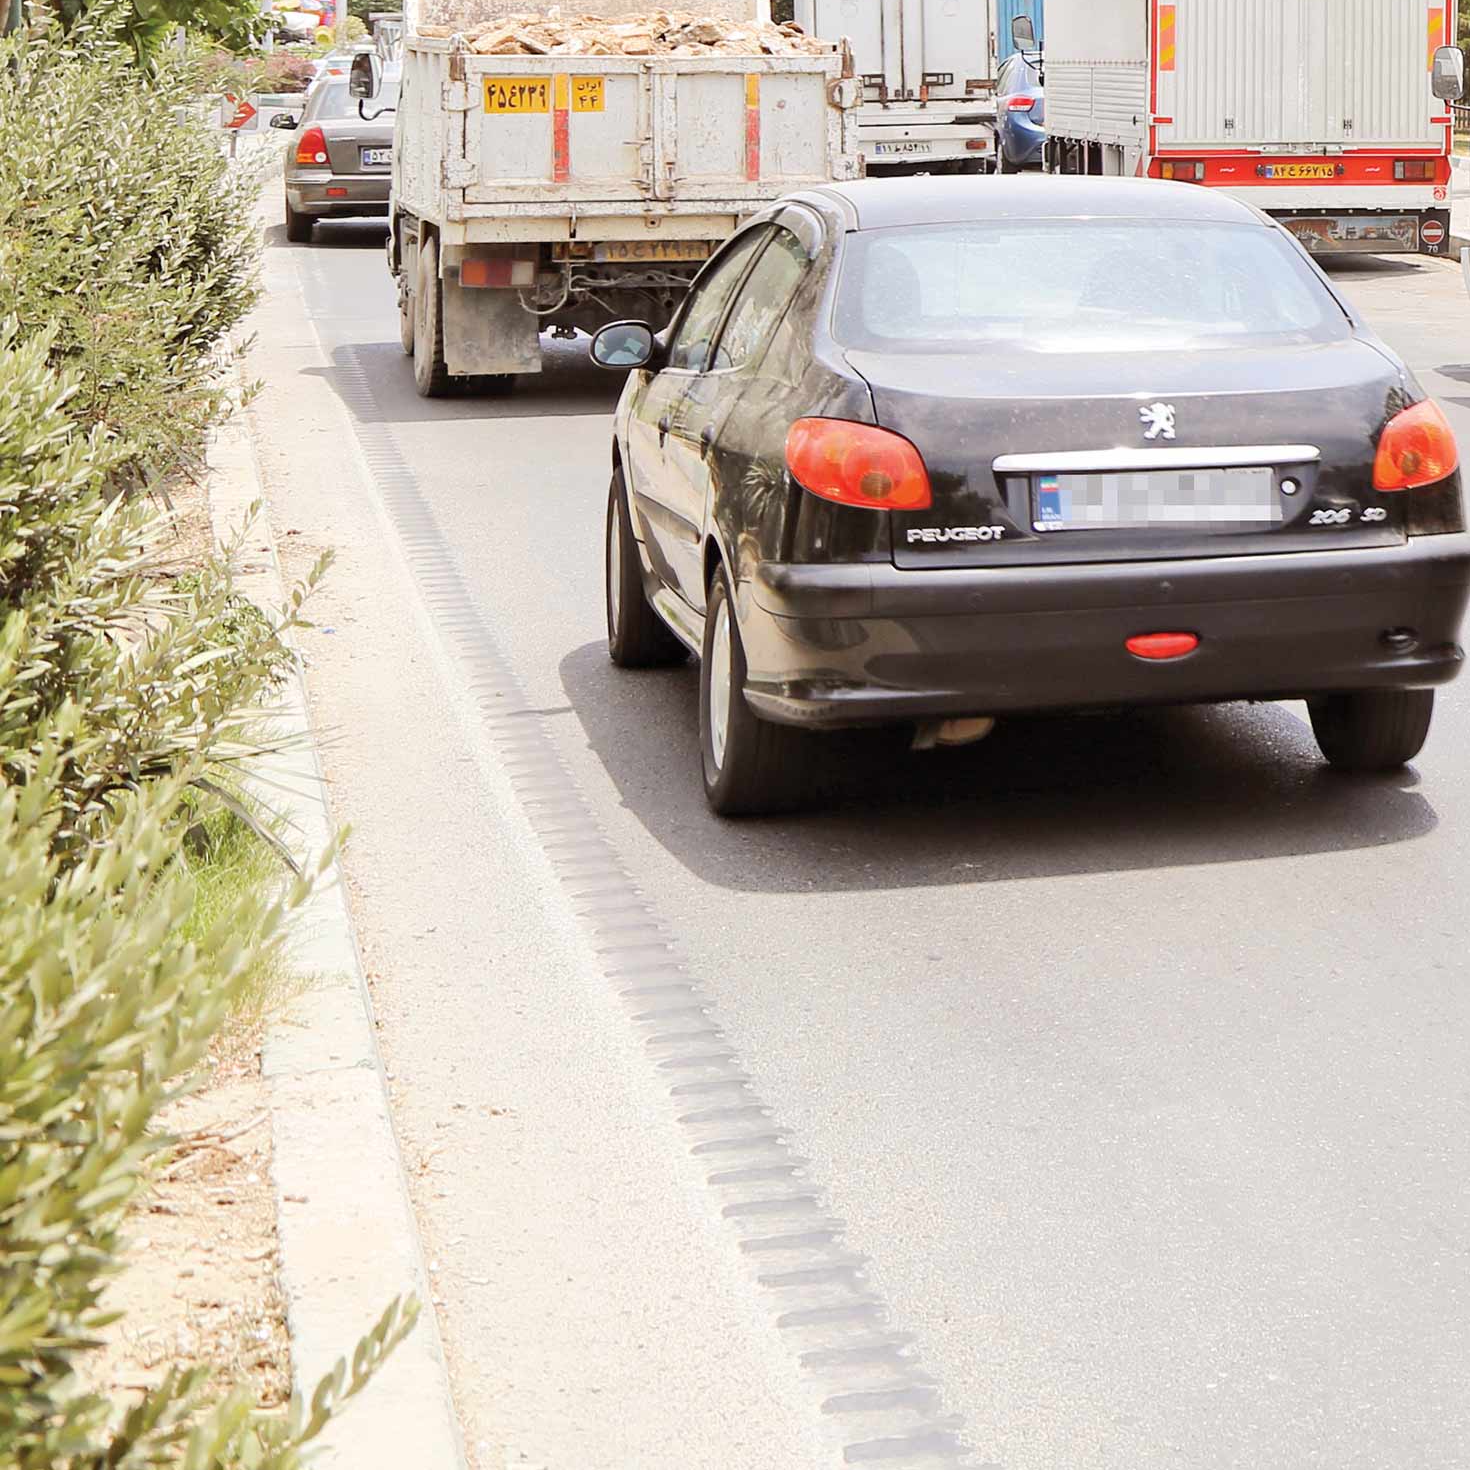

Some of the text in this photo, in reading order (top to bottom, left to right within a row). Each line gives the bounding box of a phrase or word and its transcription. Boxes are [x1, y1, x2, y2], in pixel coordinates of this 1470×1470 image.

[577, 80, 602, 92] ایران
[1308, 508, 1352, 526] 206
[906, 525, 1006, 543] PEUGEOT
